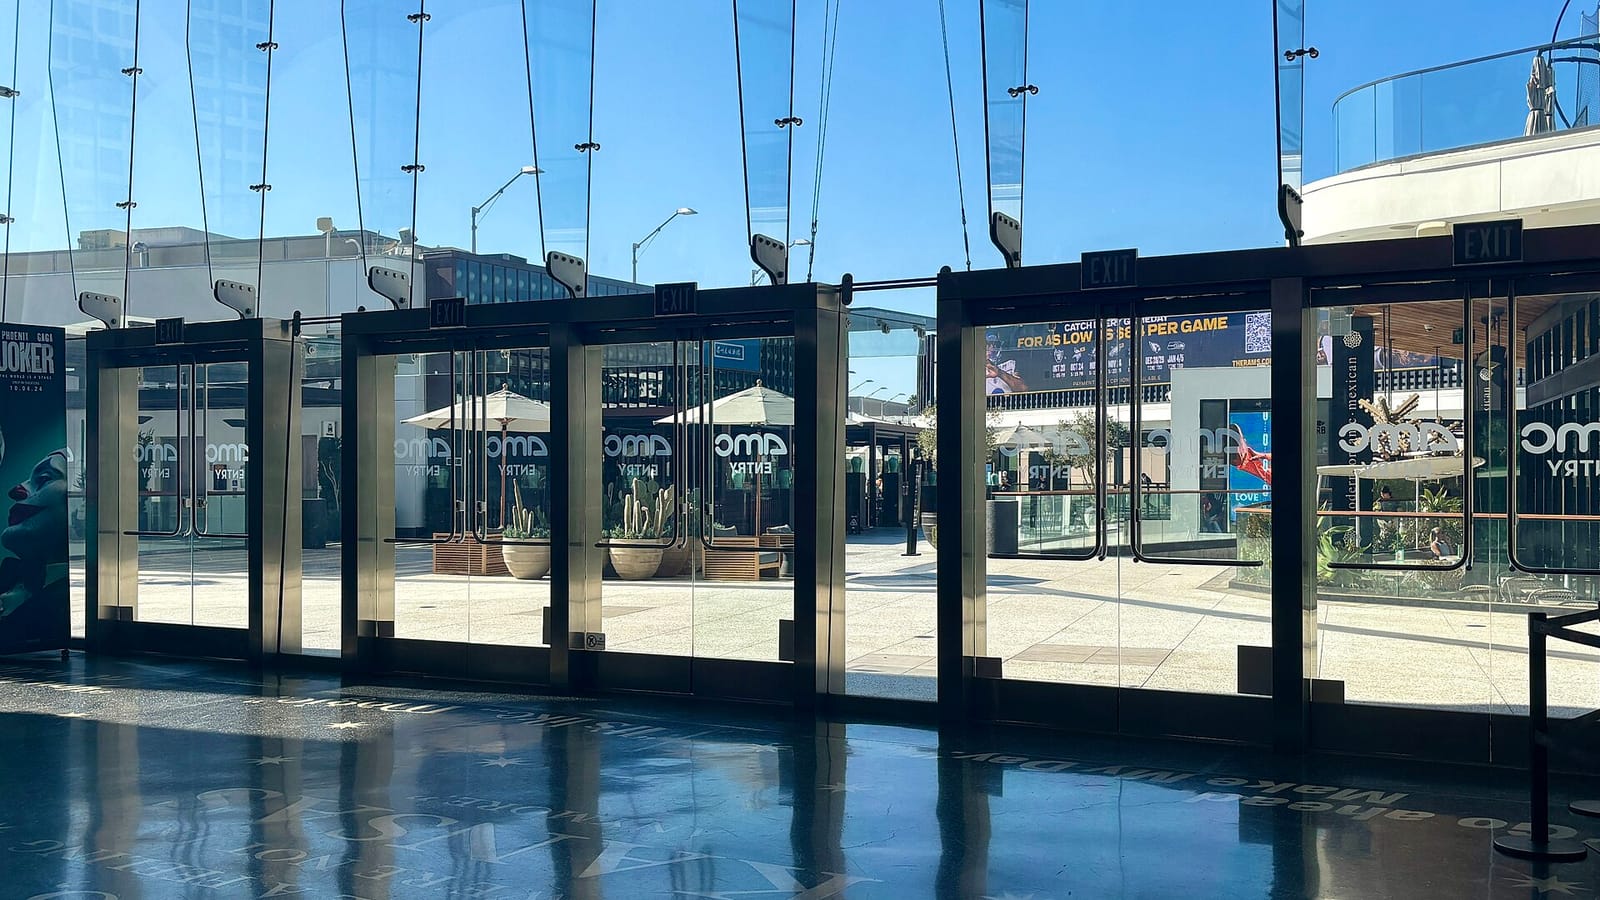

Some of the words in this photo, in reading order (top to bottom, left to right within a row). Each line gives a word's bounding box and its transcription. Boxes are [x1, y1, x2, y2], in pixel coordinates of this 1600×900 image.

[1464, 226, 1513, 259] EXIT
[1091, 255, 1130, 284] EXIT
[436, 302, 462, 324] EXIT
[662, 288, 690, 312] EXIT
[160, 321, 180, 341] EXIT
[1017, 336, 1043, 348] FOR
[1045, 334, 1061, 346] AS
[1063, 330, 1093, 345] LOW
[1147, 321, 1178, 337] PER
[1180, 316, 1228, 333] GAME
[1064, 321, 1093, 332] CATCH
[0, 341, 55, 373] JOKER
[1346, 356, 1357, 411] mexican
[1235, 493, 1260, 502] LOVE
[1077, 764, 1198, 784] My
[1206, 776, 1409, 805] Make
[1182, 790, 1437, 821] ahead
[1457, 816, 1579, 839] Go
